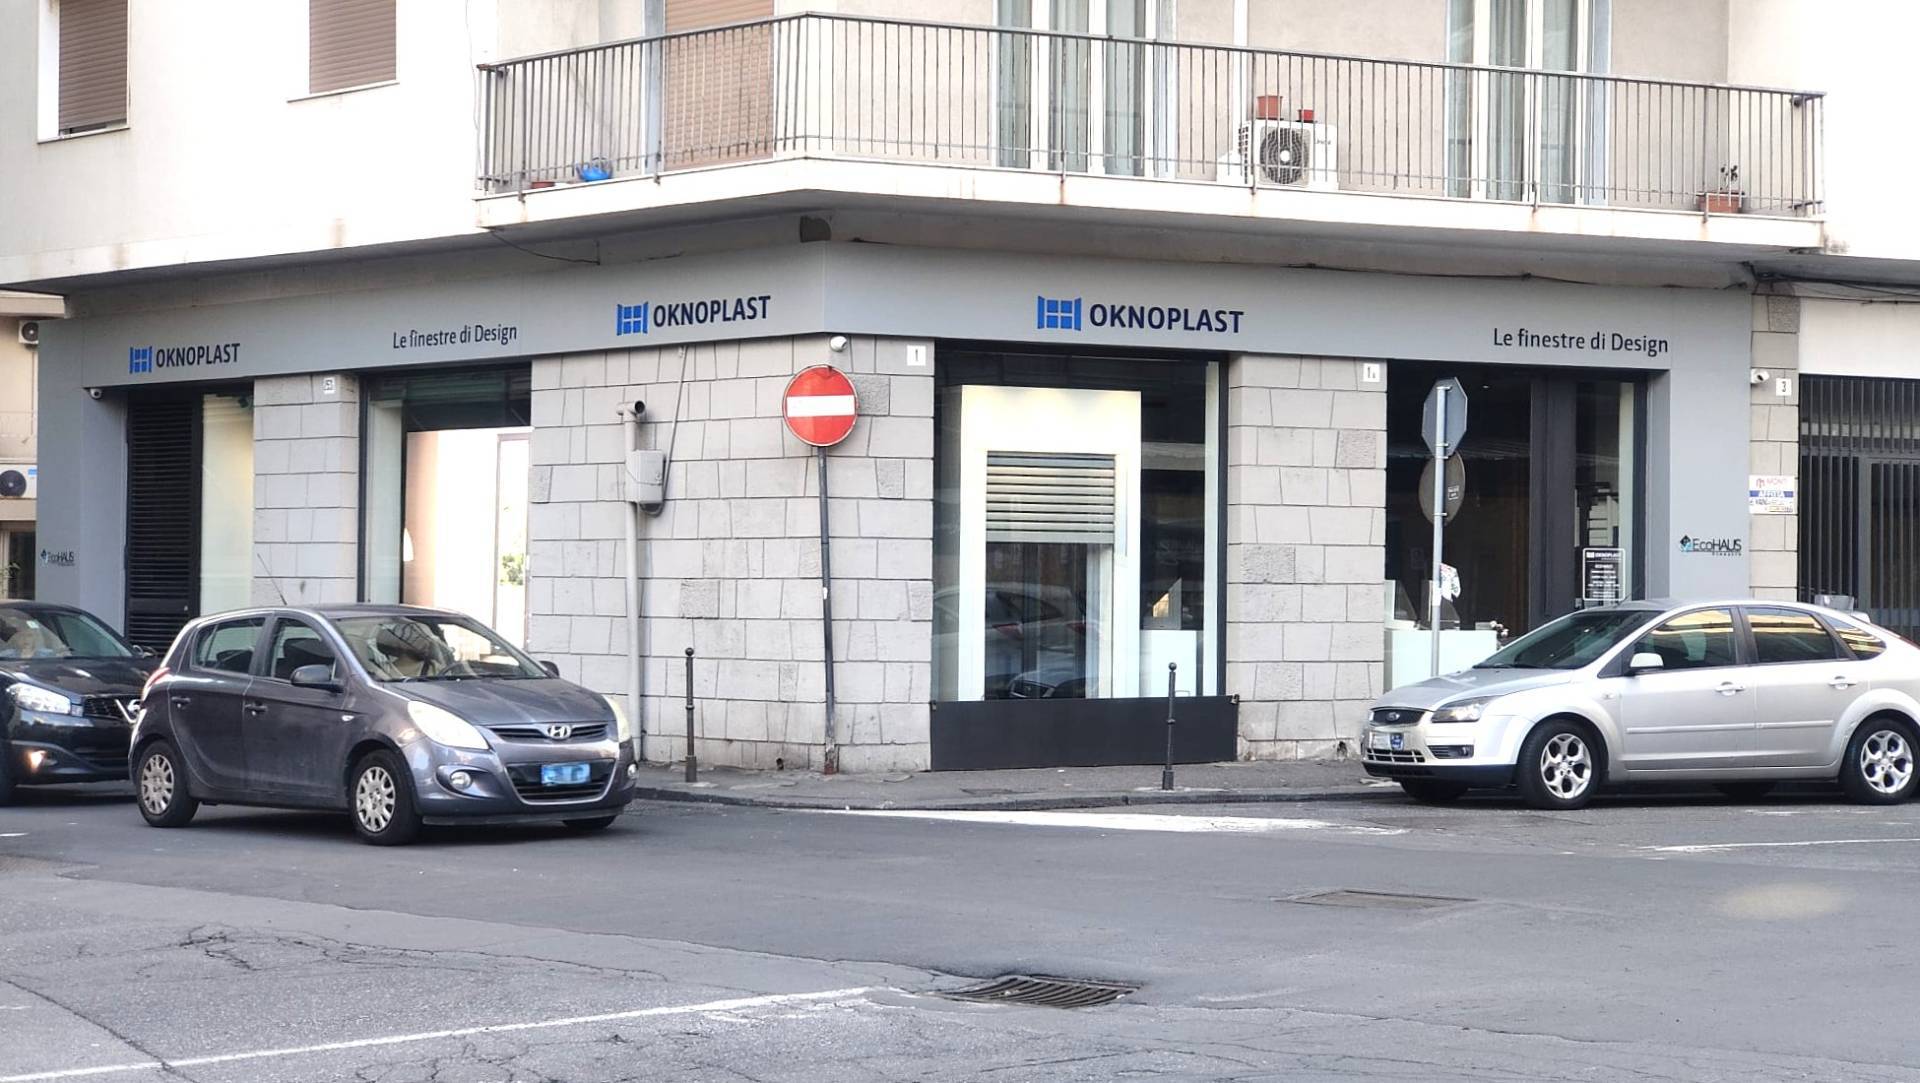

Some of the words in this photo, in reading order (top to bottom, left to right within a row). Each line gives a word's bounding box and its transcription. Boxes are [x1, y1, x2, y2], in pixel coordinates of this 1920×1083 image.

[653, 295, 772, 328] OKNOPLAST
[1089, 303, 1245, 334] OKNOPLAST
[392, 331, 407, 350] Le
[410, 329, 457, 348] finestre
[459, 324, 472, 345] di
[473, 323, 518, 346] Design
[1493, 327, 1514, 347] Le
[1517, 327, 1586, 350] finestre
[1590, 331, 1606, 351] di
[1611, 332, 1669, 358] Design
[155, 342, 241, 369] OKNOPLAST
[1781, 380, 1787, 393] 3
[1692, 538, 1742, 552] EcoHAUS
